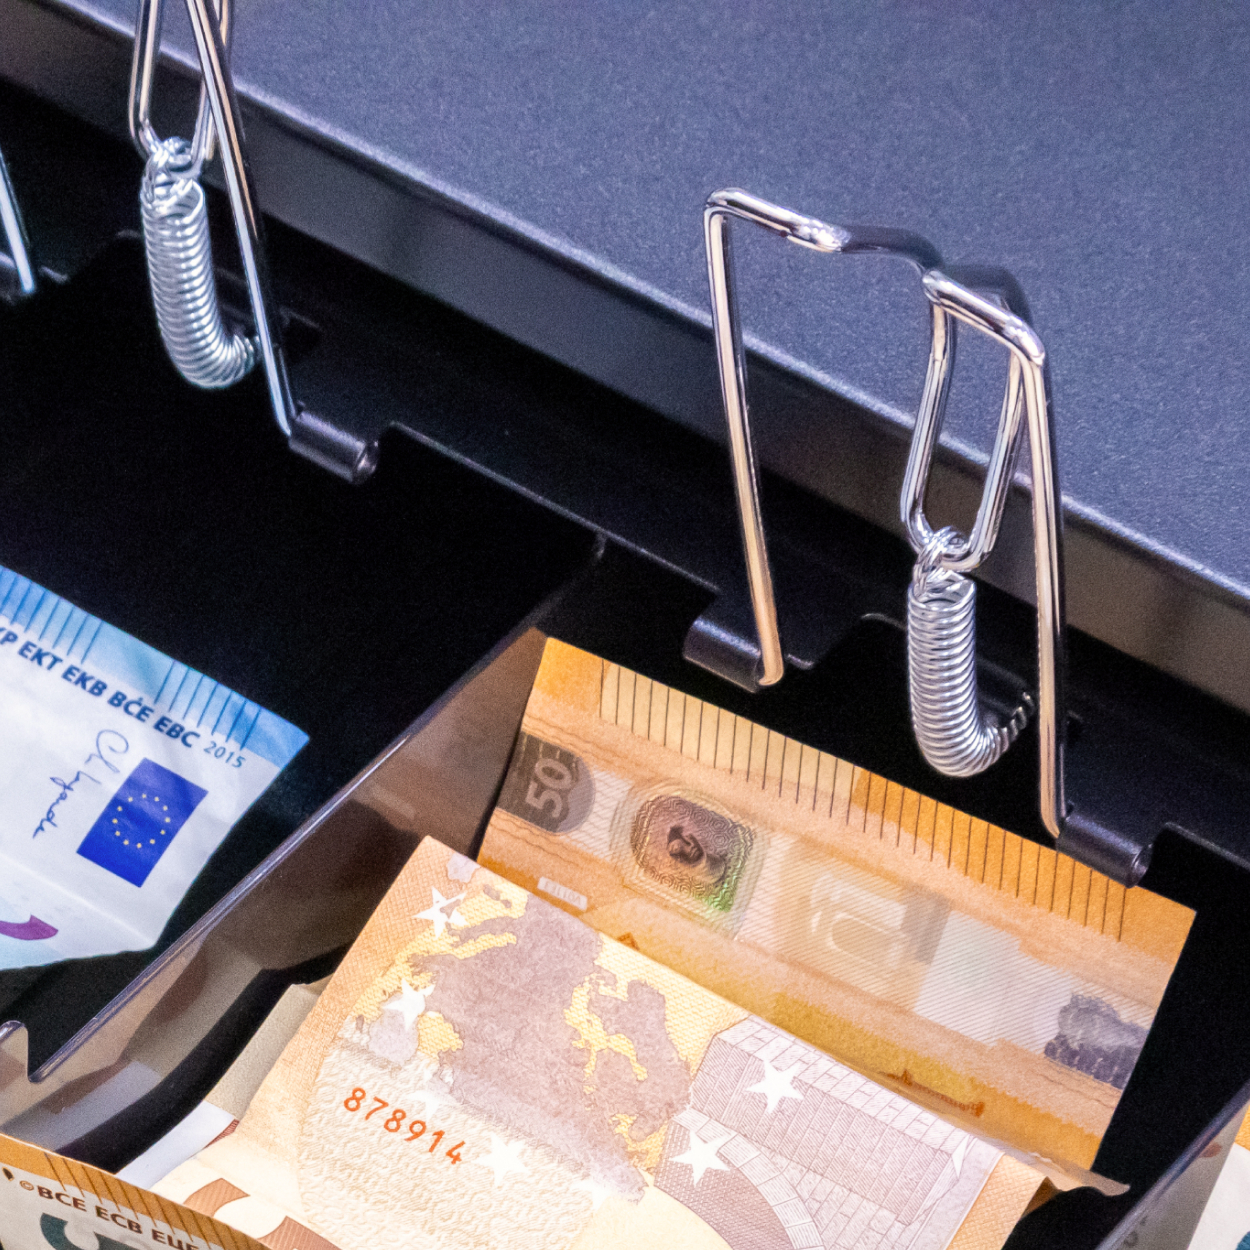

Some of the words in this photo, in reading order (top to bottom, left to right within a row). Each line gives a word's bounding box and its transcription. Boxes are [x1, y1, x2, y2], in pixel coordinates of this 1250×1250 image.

[17, 640, 63, 671] EKT
[61, 664, 108, 697] EKB
[152, 715, 201, 748] EBC
[203, 740, 246, 770] 2015
[524, 757, 573, 820] 50
[343, 1086, 466, 1165] 878914
[95, 1204, 143, 1234] ECB
